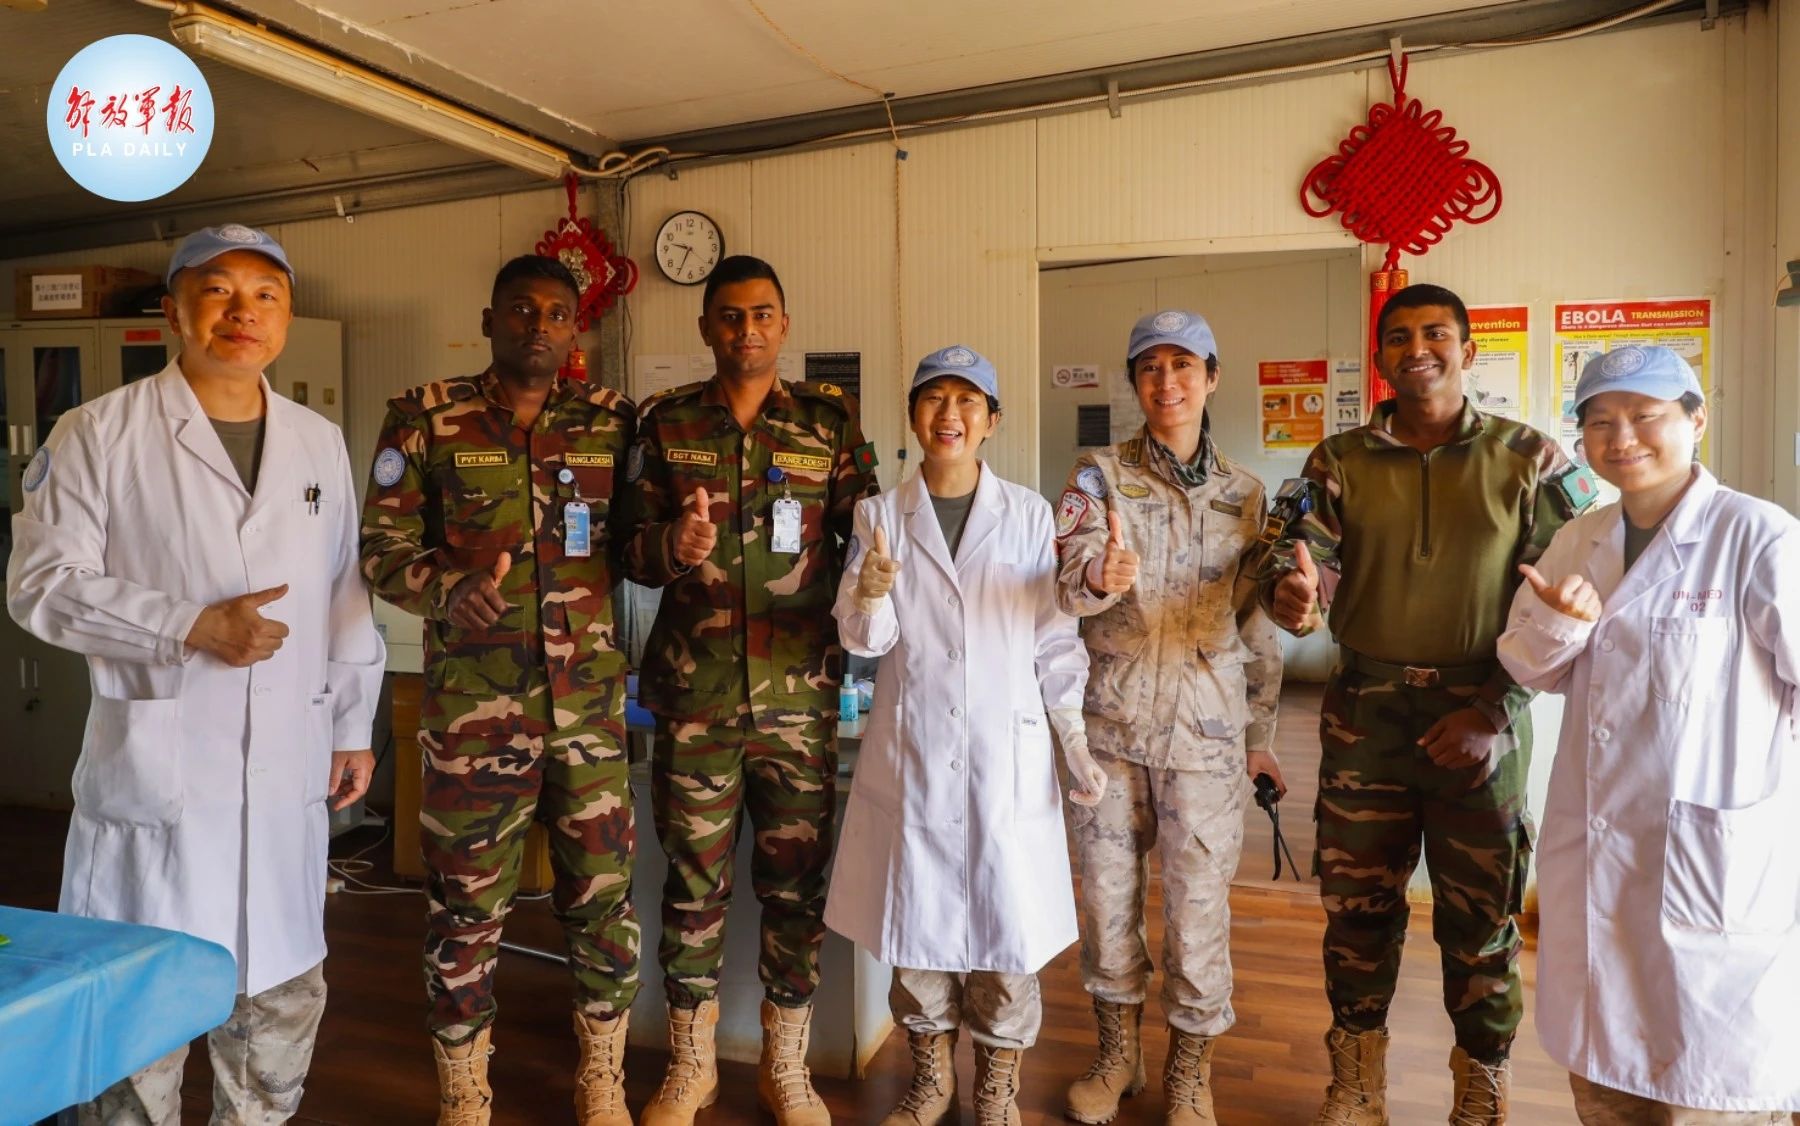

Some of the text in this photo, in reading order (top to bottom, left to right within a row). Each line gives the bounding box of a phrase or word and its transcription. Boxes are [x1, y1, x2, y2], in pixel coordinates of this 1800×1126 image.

[675, 223, 682, 231] 11
[686, 219, 694, 227] 12
[708, 231, 714, 239] 2
[664, 245, 669, 253] 9
[712, 244, 717, 252] 3
[675, 267, 682, 276] 7
[688, 271, 692, 279] 6
[699, 267, 704, 275] 5
[1561, 309, 1704, 325] EBOLA TRANSMISSION
[1470, 318, 1521, 330] evention
[461, 455, 503, 465] PVT KARIM
[673, 452, 689, 460] SGT
[567, 456, 611, 465] BANGLADESH
[776, 455, 828, 468] BANGLADESH
[1672, 590, 1723, 601] UN-MED
[1690, 602, 1706, 613] 02
